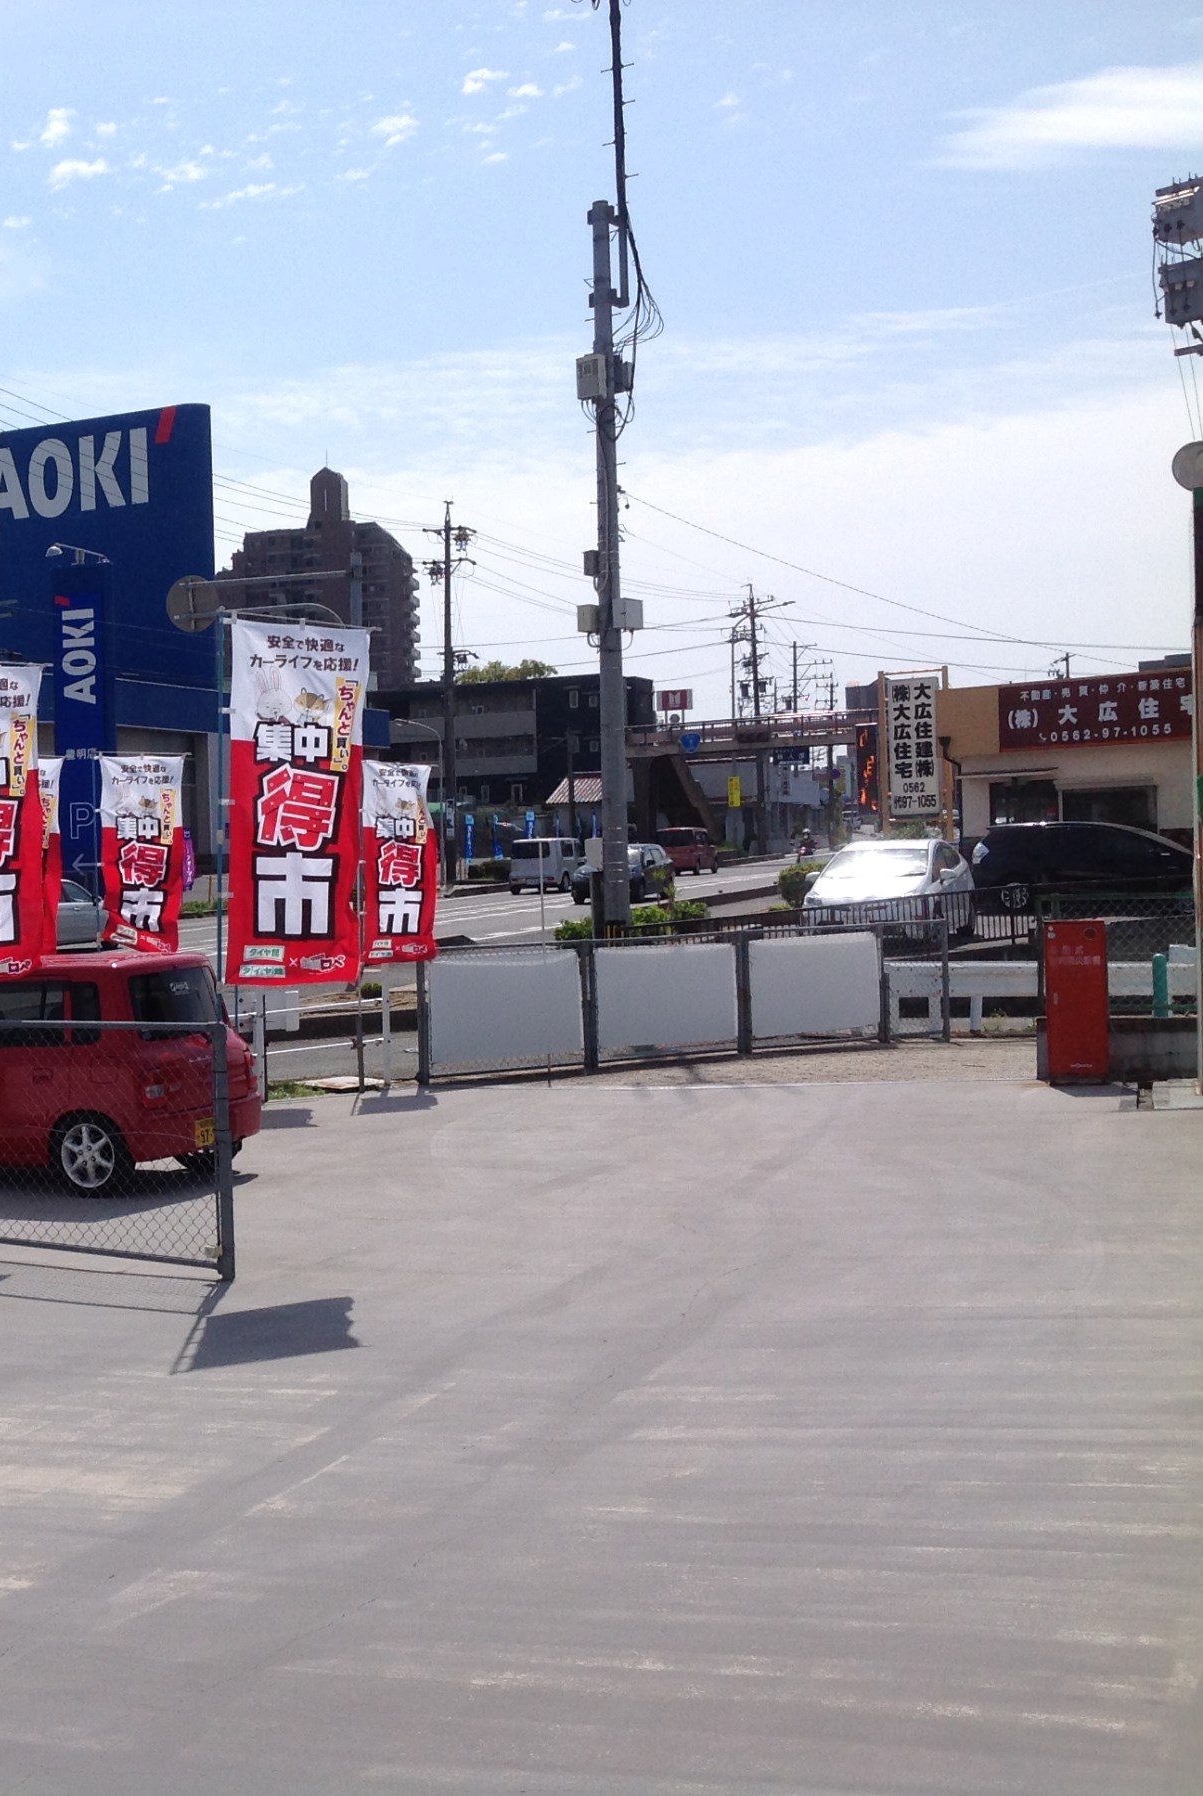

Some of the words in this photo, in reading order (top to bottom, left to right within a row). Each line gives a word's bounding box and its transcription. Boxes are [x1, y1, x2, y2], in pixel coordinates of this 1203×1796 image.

[62, 608, 97, 705] AOKI
[267, 635, 346, 653] 安全で快適な
[255, 723, 328, 762] 集中
[1050, 723, 1172, 743] 0562-97-1055
[257, 763, 339, 851] 得
[903, 782, 925, 793] 0562
[70, 802, 96, 839] P
[118, 840, 168, 888] 得
[378, 839, 422, 888] 得
[120, 887, 164, 932] 市
[255, 851, 333, 935] 市
[378, 887, 422, 933] 市
